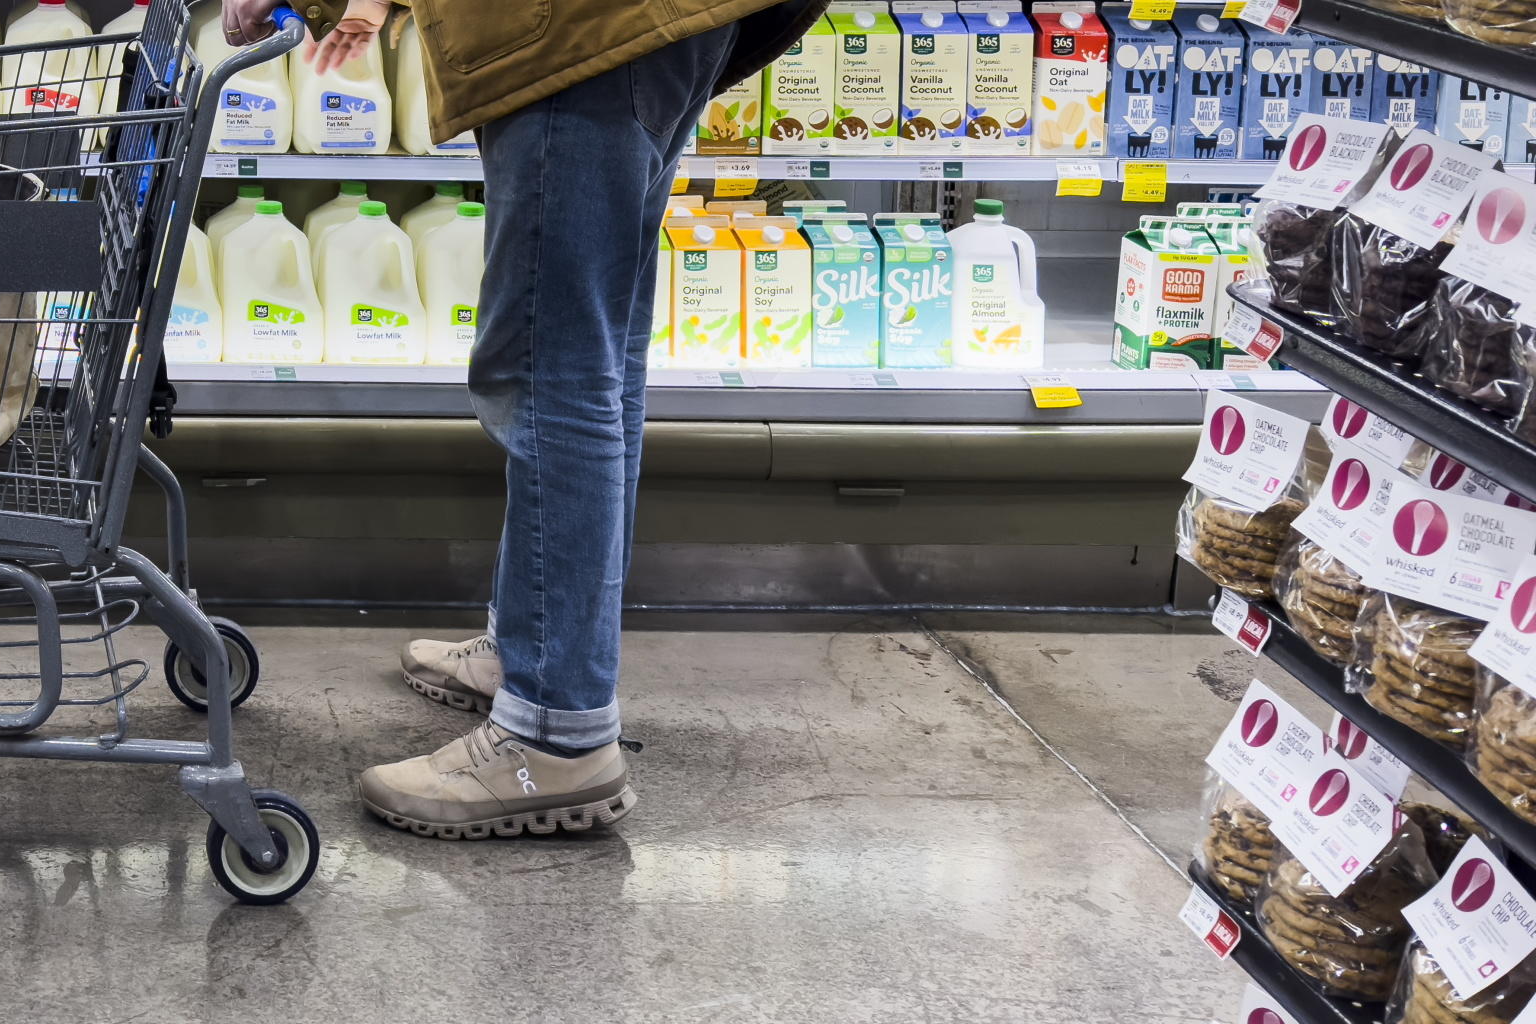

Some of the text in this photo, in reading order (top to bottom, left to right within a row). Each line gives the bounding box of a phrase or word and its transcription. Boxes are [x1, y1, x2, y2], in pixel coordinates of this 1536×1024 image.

[1117, 46, 1174, 69] OAT-
[842, 75, 880, 85] Original
[910, 75, 943, 84] Vanilla
[1049, 68, 1089, 77] Original
[842, 85, 884, 95] Coconut
[1049, 77, 1068, 86] Oat
[1125, 71, 1165, 94] LY!
[910, 86, 952, 95] Coconut
[1337, 132, 1376, 149] CHOCOLATE
[1329, 144, 1366, 161] BLACKOUT
[1166, 273, 1201, 283] GOOD
[683, 286, 722, 298] Original
[814, 268, 882, 307] Silk
[884, 267, 950, 307] Silk
[1166, 283, 1199, 293] KARMA
[683, 296, 701, 307] Soy
[1156, 306, 1205, 321] flaxmilk
[1255, 418, 1283, 437] OATMEAL
[1249, 441, 1266, 454] CHIP
[1253, 429, 1288, 451] CHOCOLATE
[1202, 456, 1233, 474] whisked
[1463, 512, 1505, 532] OATMEAL
[1460, 527, 1515, 549] CHOCOLATE
[1457, 542, 1481, 554] CHIP
[1386, 555, 1434, 577] whisked
[1433, 898, 1458, 929] whisked
[1491, 905, 1511, 923] CHIP
